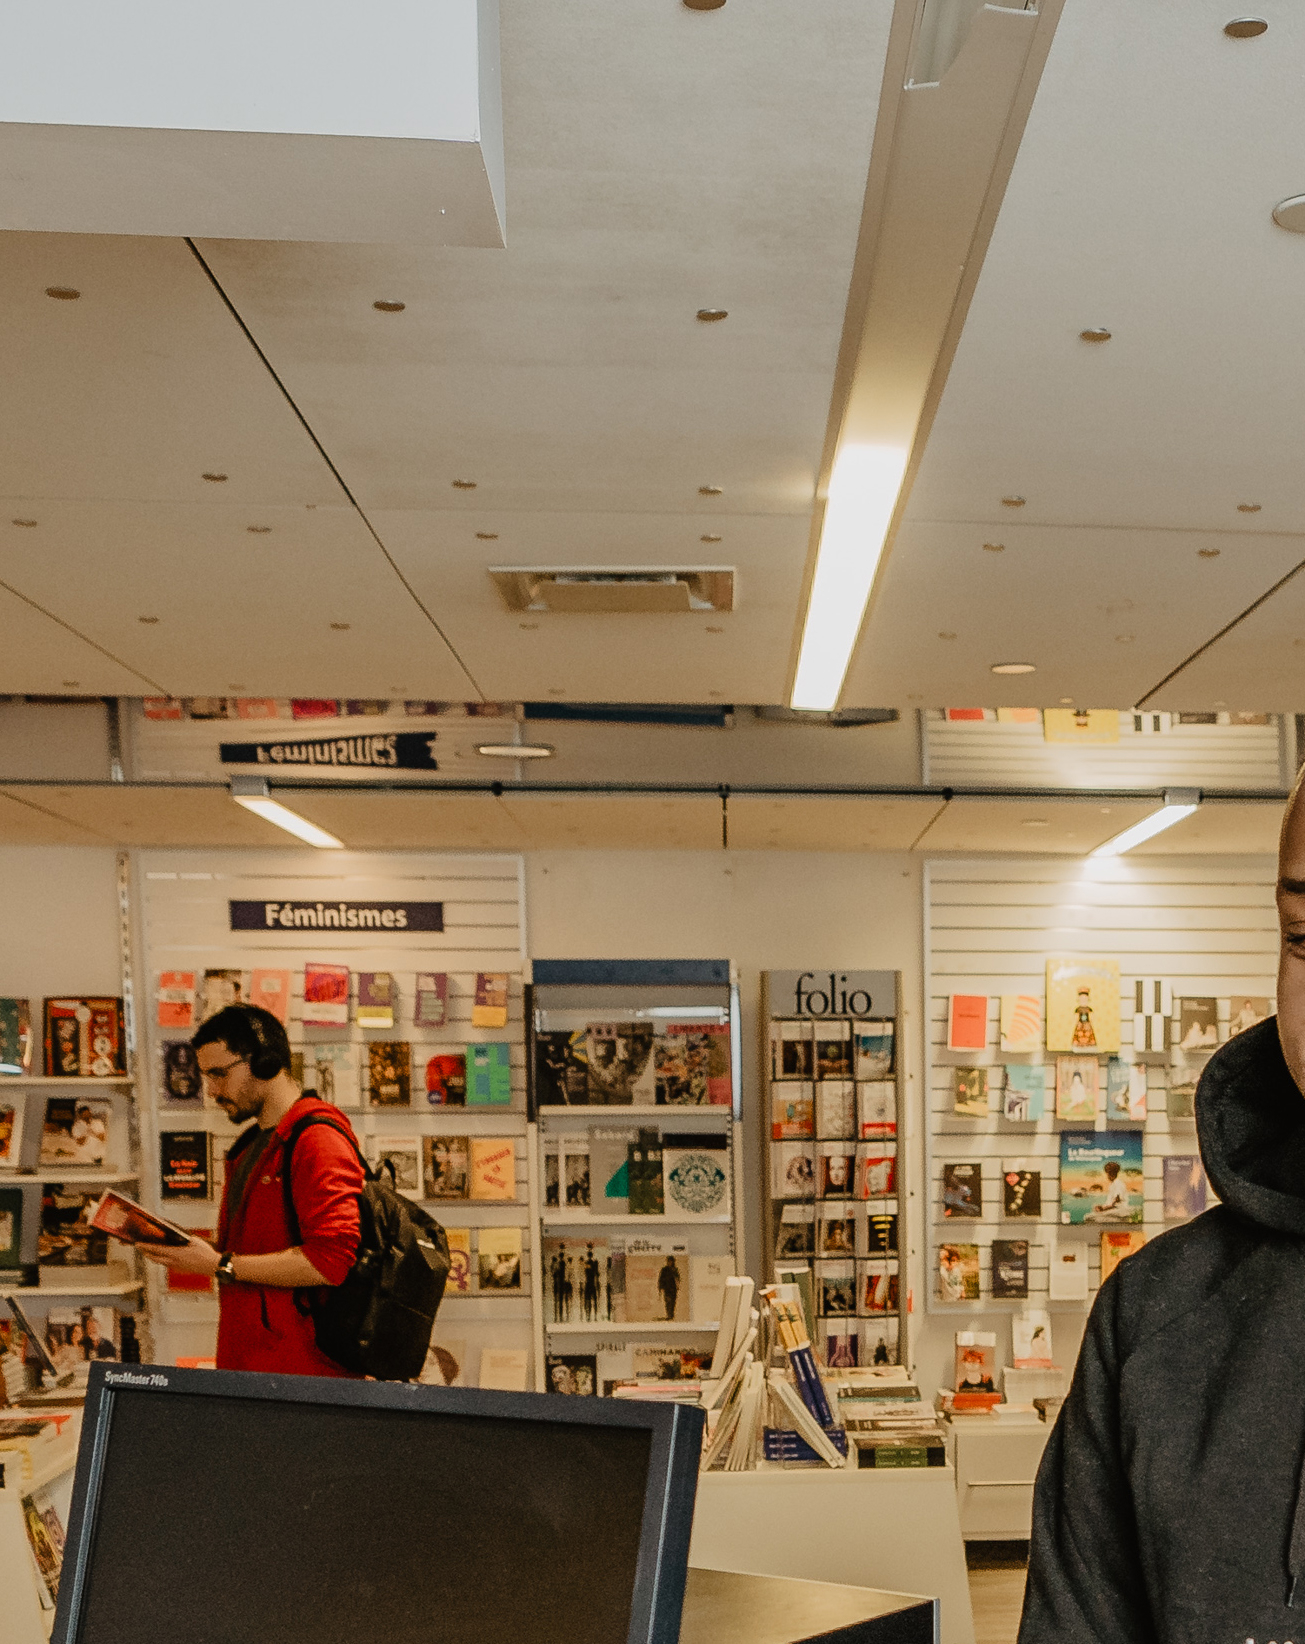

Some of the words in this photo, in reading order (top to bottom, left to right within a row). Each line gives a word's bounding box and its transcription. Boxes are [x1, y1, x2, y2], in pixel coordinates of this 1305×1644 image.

[264, 902, 408, 930] Féminismes
[794, 972, 873, 1016] folio
[104, 1370, 150, 1385] SyncMaster
